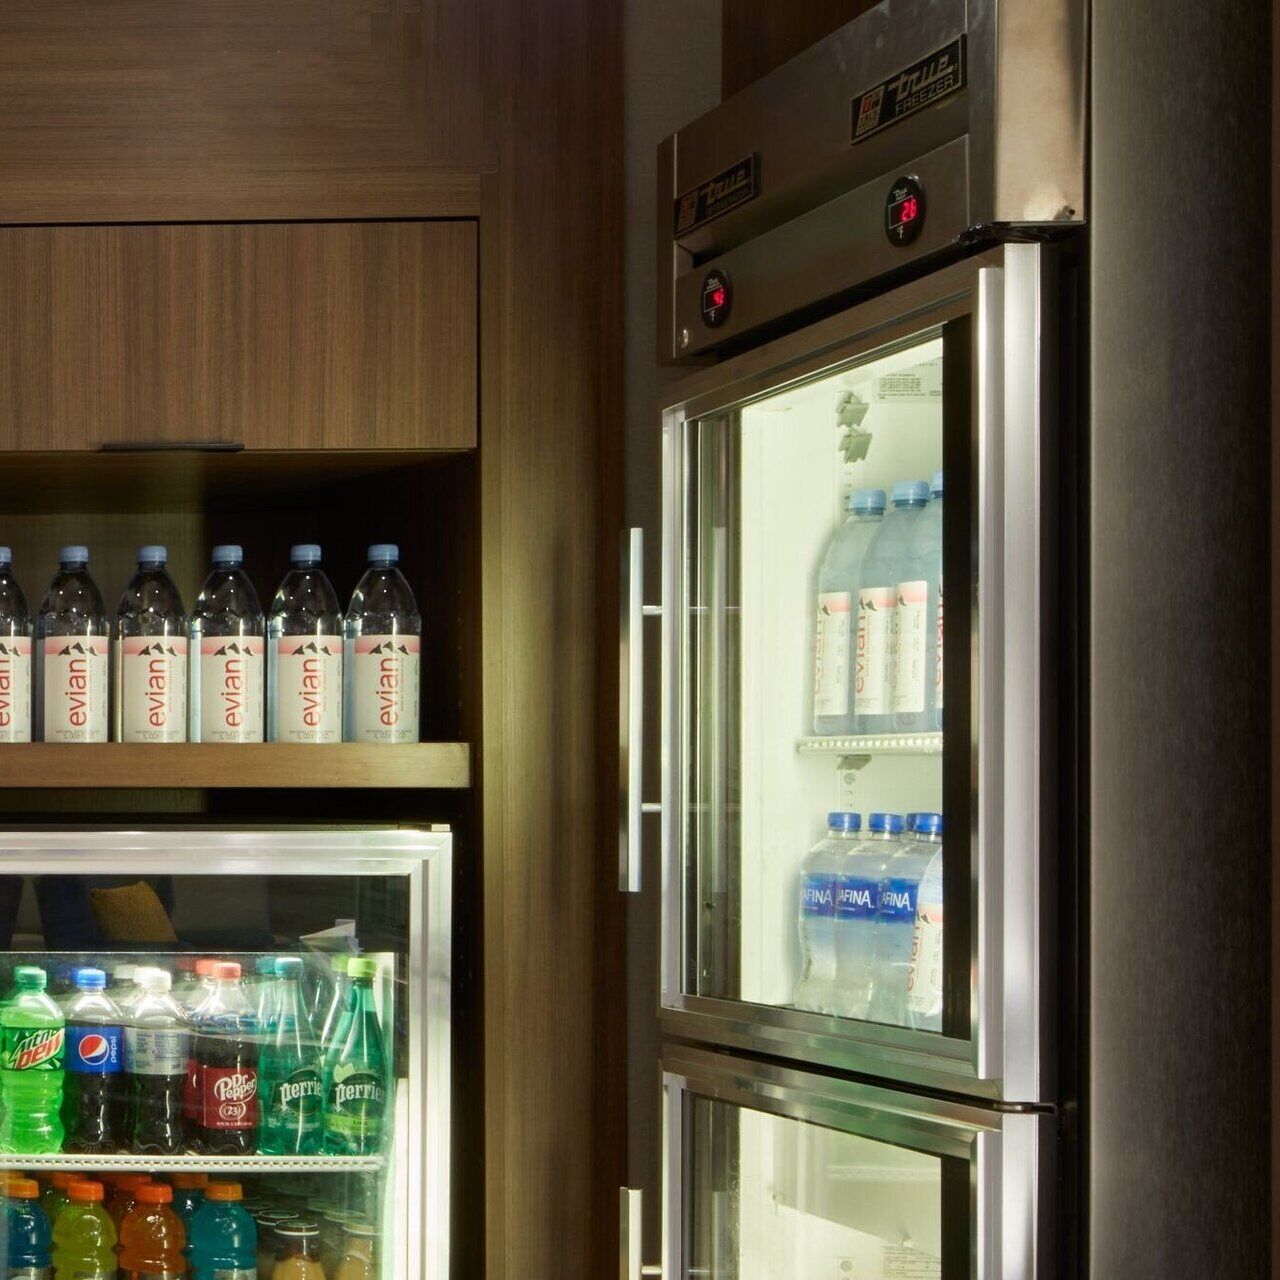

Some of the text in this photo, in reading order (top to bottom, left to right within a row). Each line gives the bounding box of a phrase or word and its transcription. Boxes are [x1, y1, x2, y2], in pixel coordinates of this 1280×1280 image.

[896, 75, 953, 116] FREEZER
[65, 658, 87, 727] evian
[145, 658, 167, 727] evian
[221, 658, 242, 727] evian
[299, 658, 320, 727] evian
[376, 657, 399, 727] evian
[109, 1035, 118, 1064] pepsi
[219, 1076, 257, 1101] Pepper
[232, 1073, 249, 1088] Dr
[226, 1105, 239, 1115] 23
